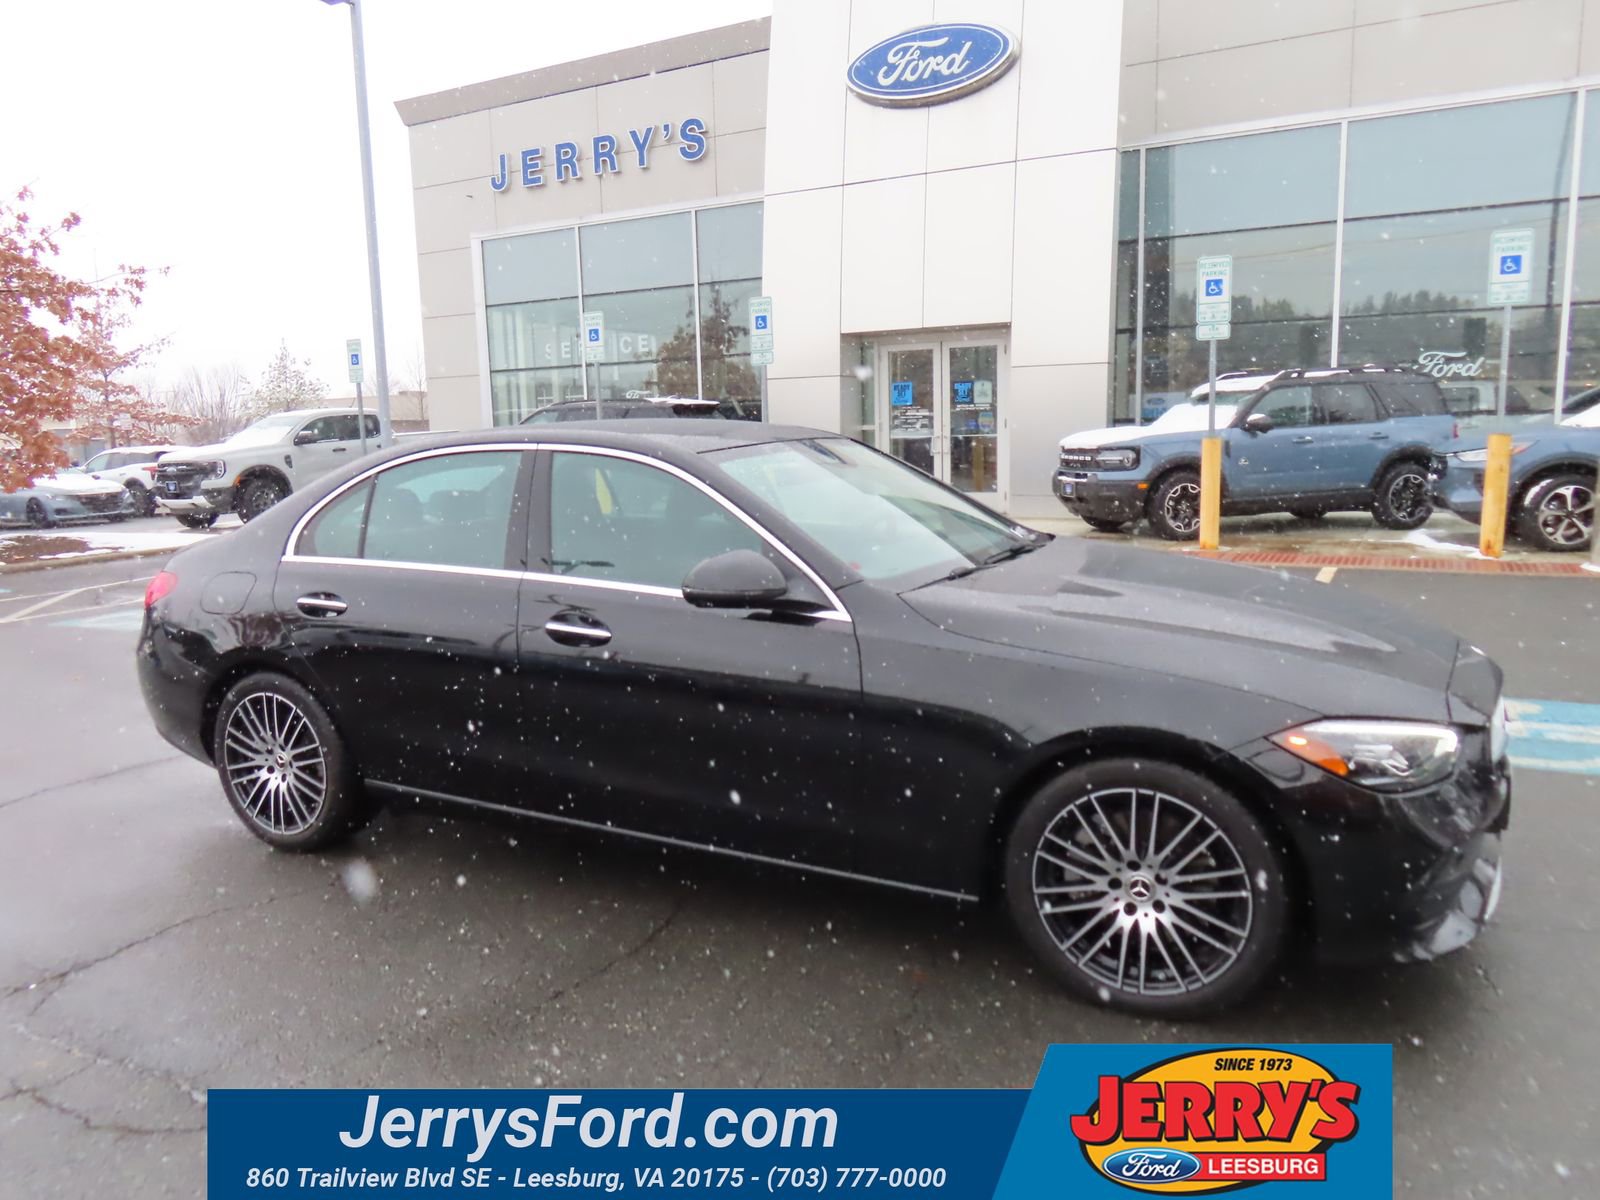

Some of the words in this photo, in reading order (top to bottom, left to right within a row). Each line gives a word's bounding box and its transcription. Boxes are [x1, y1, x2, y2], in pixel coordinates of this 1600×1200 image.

[877, 36, 973, 86] Ford
[490, 117, 707, 192] JERRY'S
[1412, 351, 1485, 377] Ford
